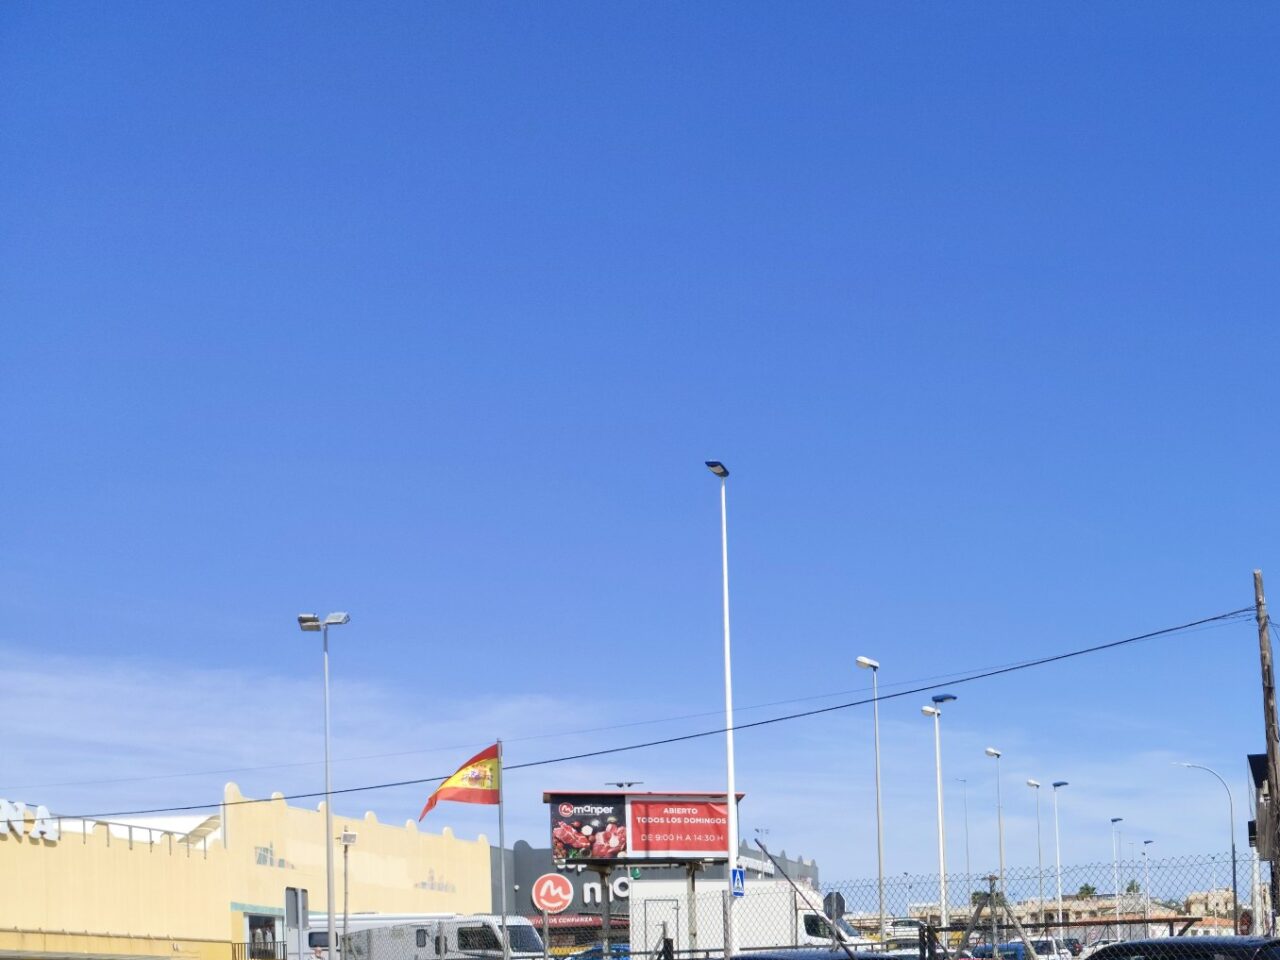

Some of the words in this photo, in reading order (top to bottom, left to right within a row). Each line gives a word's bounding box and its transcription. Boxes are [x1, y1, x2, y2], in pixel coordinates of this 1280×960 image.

[573, 804, 614, 816] manper
[663, 807, 698, 815] ABIERTO
[636, 816, 665, 824] TODOS
[666, 816, 682, 824] LOS
[683, 817, 727, 825] DOMINGOS
[641, 833, 654, 842] DE
[655, 833, 674, 842] 9:00
[685, 833, 692, 841] A
[694, 833, 715, 842] 14:30
